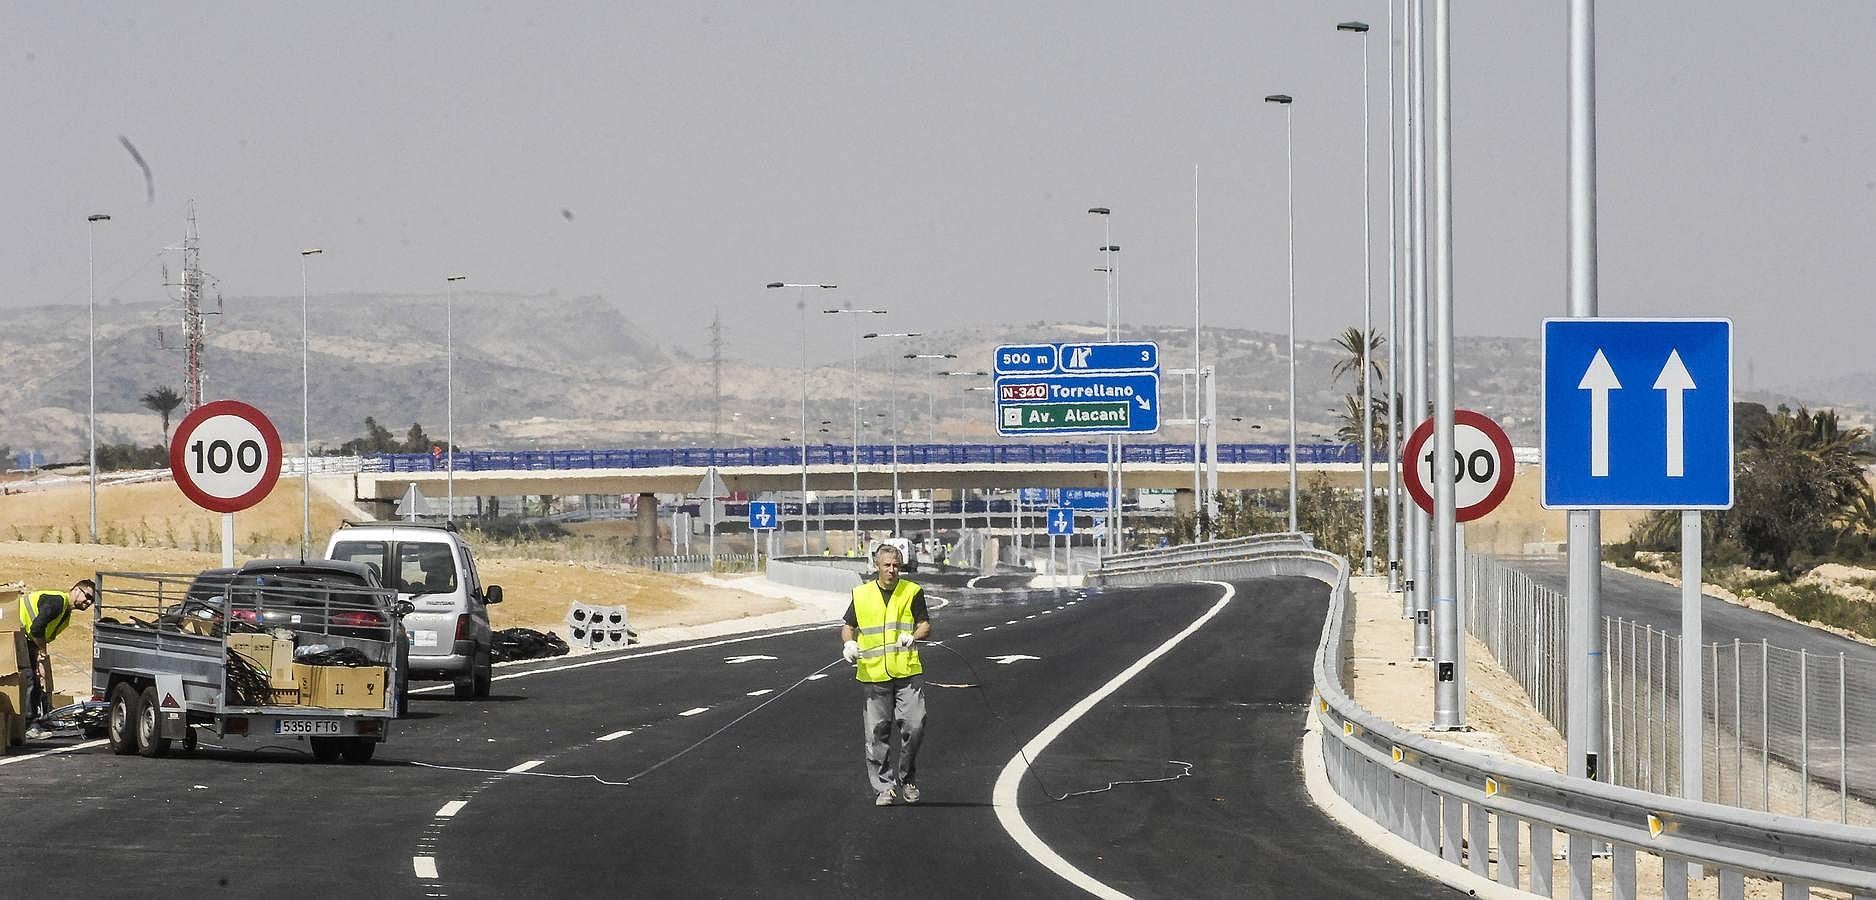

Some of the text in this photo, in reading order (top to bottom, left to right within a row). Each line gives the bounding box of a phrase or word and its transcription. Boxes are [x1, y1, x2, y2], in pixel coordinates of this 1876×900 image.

[1003, 353, 1048, 365] 500 m
[1141, 351, 1150, 362] 3
[1002, 384, 1134, 398] N-340 Torrellano
[1029, 407, 1126, 423] Av. Alacant
[191, 440, 262, 473] 100
[283, 721, 312, 733] 5356
